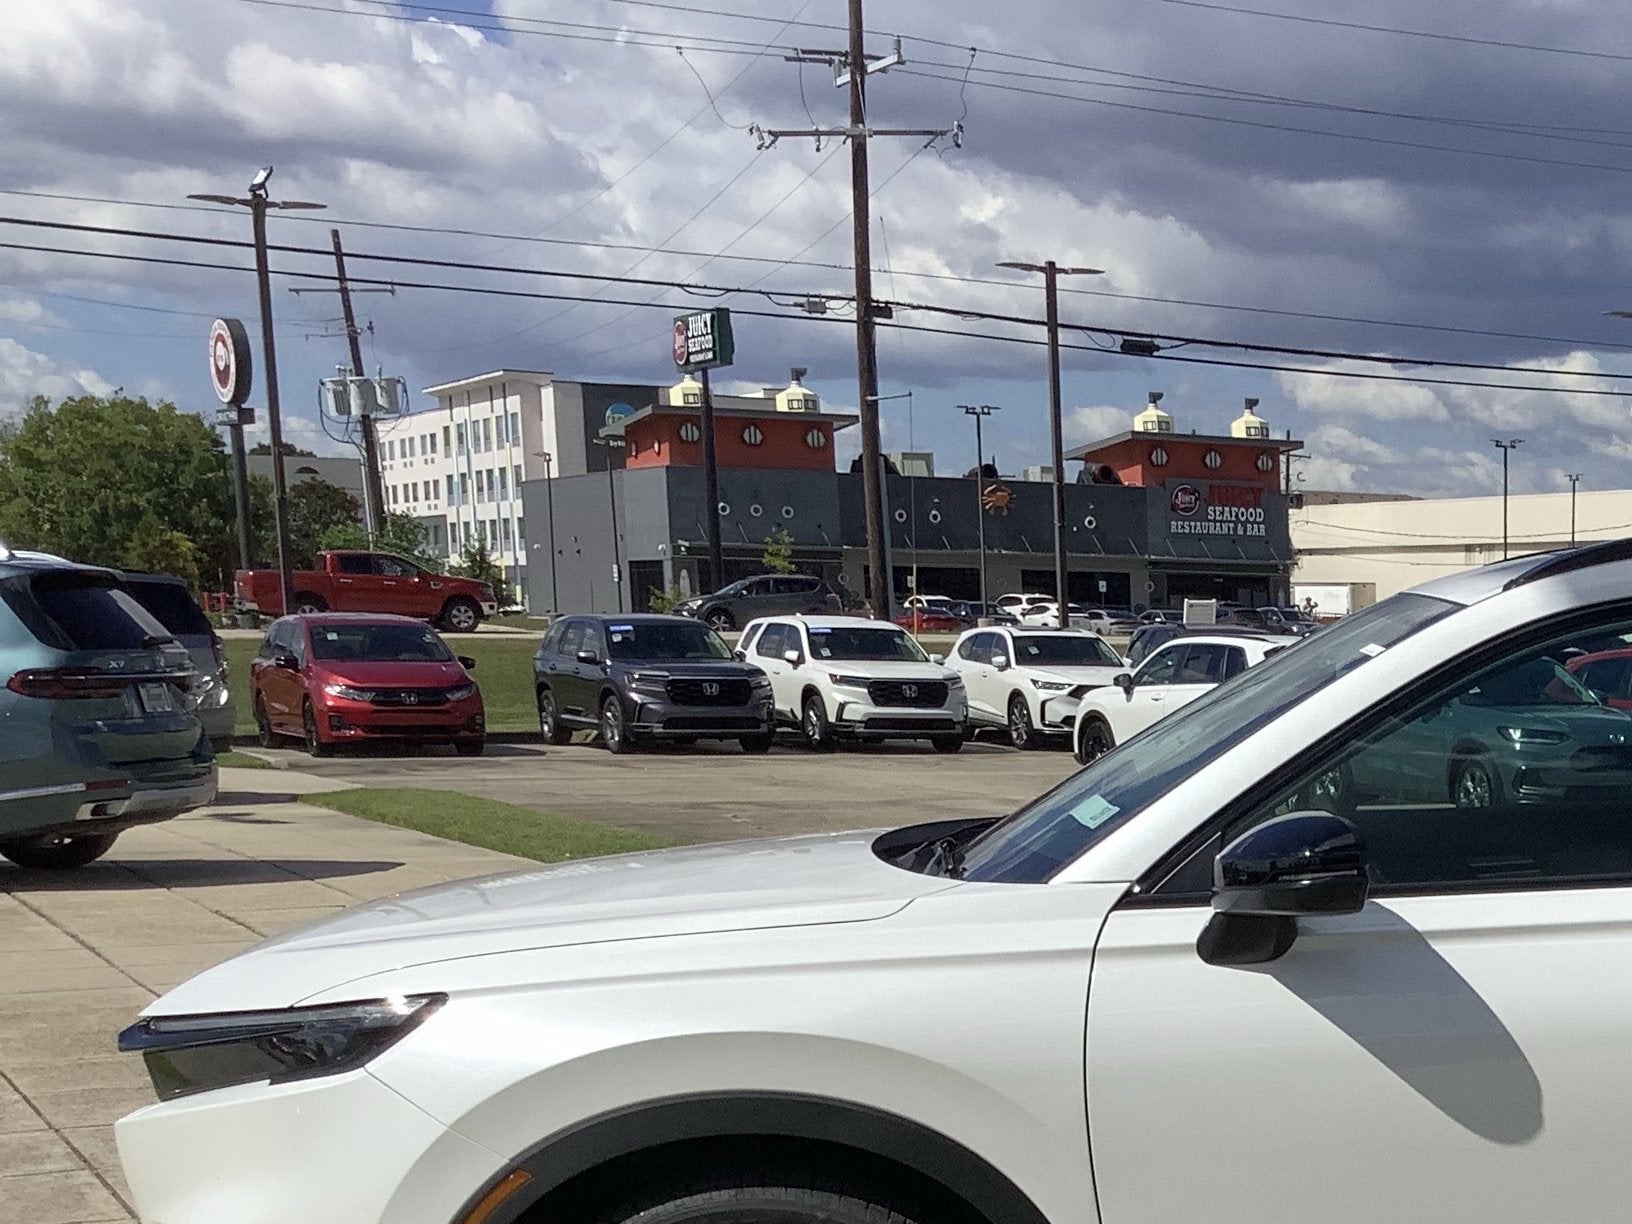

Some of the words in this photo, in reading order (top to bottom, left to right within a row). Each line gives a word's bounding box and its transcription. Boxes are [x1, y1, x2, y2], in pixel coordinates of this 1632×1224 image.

[688, 313, 711, 337] JUICY
[1208, 505, 1264, 522] SEAFOOD
[1171, 520, 1235, 535] RESTAURANT
[1237, 522, 1244, 535] &
[1246, 523, 1266, 536] BAR
